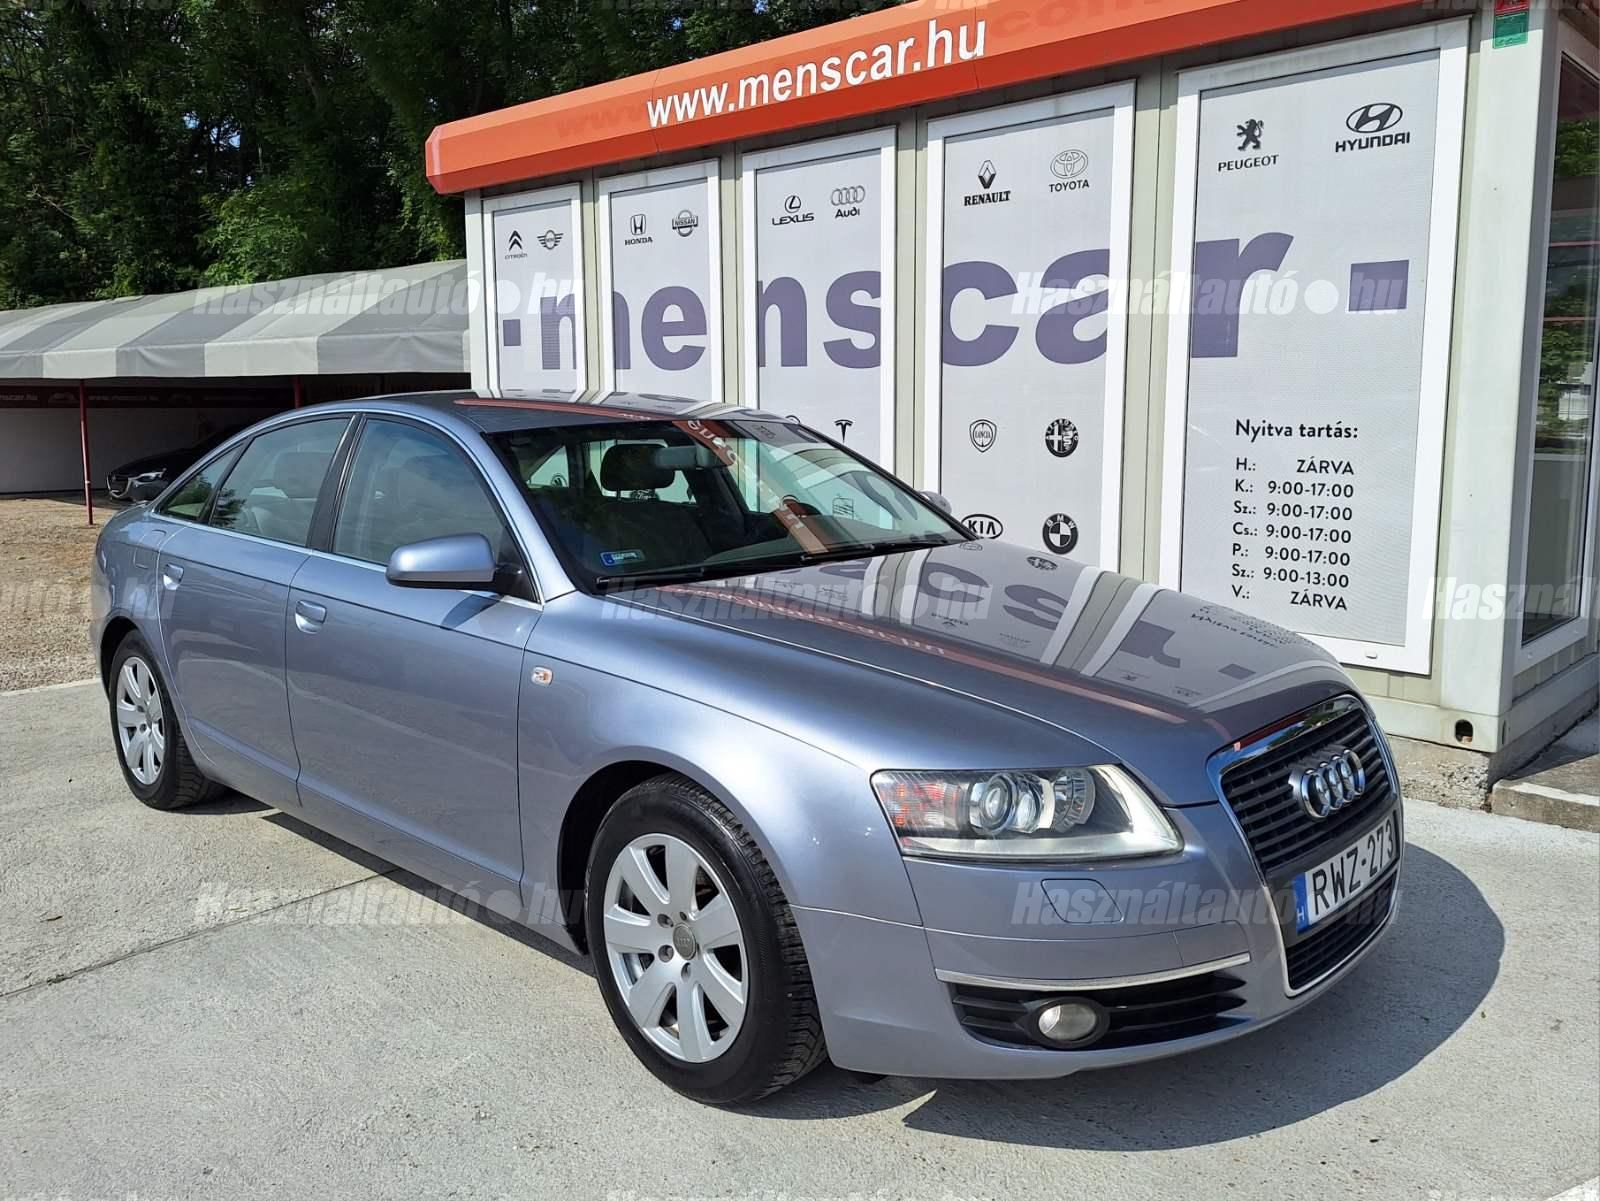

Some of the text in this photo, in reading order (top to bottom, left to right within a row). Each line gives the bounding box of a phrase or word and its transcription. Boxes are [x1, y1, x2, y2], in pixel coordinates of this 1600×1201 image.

[647, 19, 986, 128] www.menscar.hu
[1335, 131, 1411, 153] HYUNDAI
[1217, 154, 1280, 172] PEUGEOT
[1049, 179, 1090, 193] TOYOTA
[964, 190, 1011, 206] RENAULT
[674, 219, 696, 227] NISSAN
[771, 212, 815, 226] LEXUS
[624, 236, 653, 246] HONDA
[1235, 419, 1358, 442] Nyitva tartás:
[1236, 456, 1354, 475] H.: ZÁRVA
[1235, 479, 1354, 498] K.: 9:00-17:00
[1233, 501, 1353, 521] Sz.: 9:00-17:00
[968, 520, 996, 535] KIA
[1232, 522, 1352, 544] Cs.: 9:00-17:00
[1232, 543, 1351, 567] P.: 9:00-17:00
[1231, 564, 1349, 588] Sz.: 9:00-13:00
[1231, 585, 1347, 610] V.: ZÁRVA
[1313, 819, 1394, 915] RWZ-273
